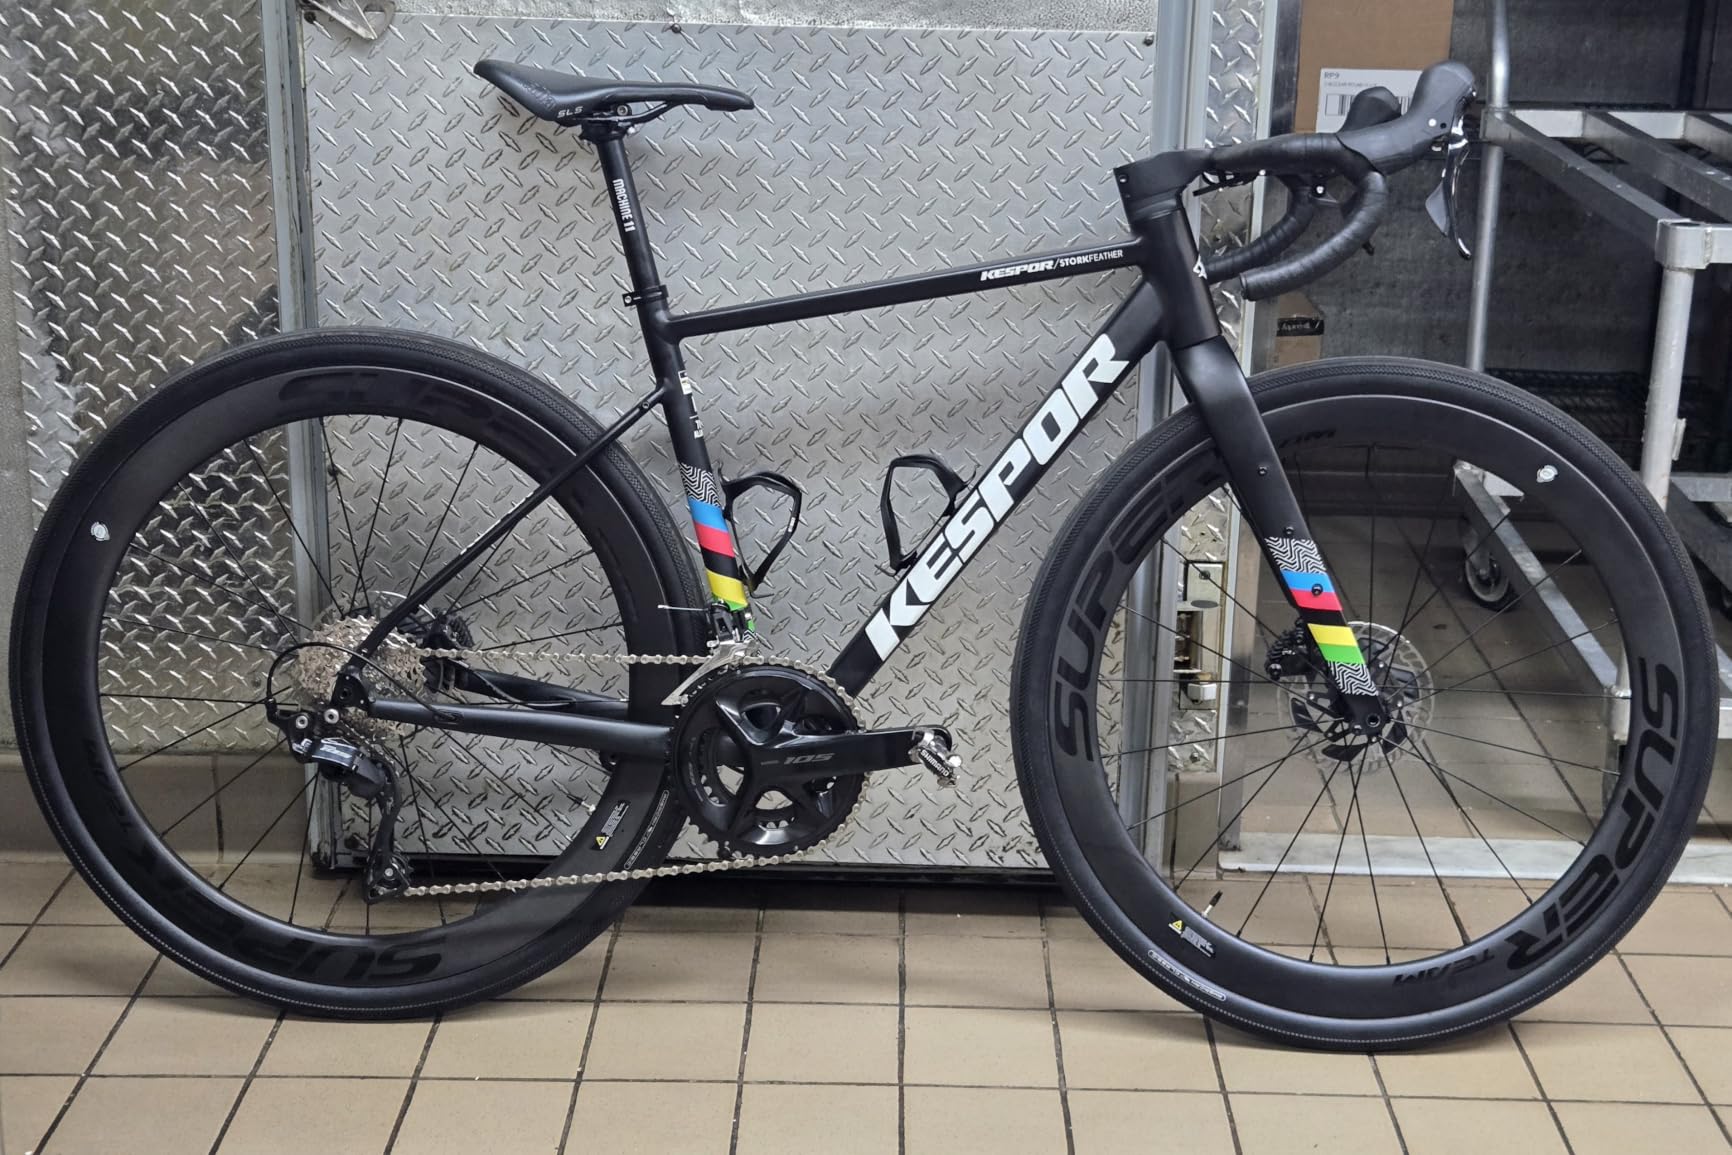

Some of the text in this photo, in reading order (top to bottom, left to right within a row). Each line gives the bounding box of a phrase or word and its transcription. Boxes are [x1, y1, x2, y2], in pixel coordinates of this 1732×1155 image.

[556, 106, 583, 118] SLS
[612, 178, 636, 233] MACHINE 11
[864, 333, 1130, 662] KESPOR
[783, 752, 836, 765] 105
[920, 749, 950, 777] SHIMANO
[1393, 656, 1680, 987] SUPER TEAM
